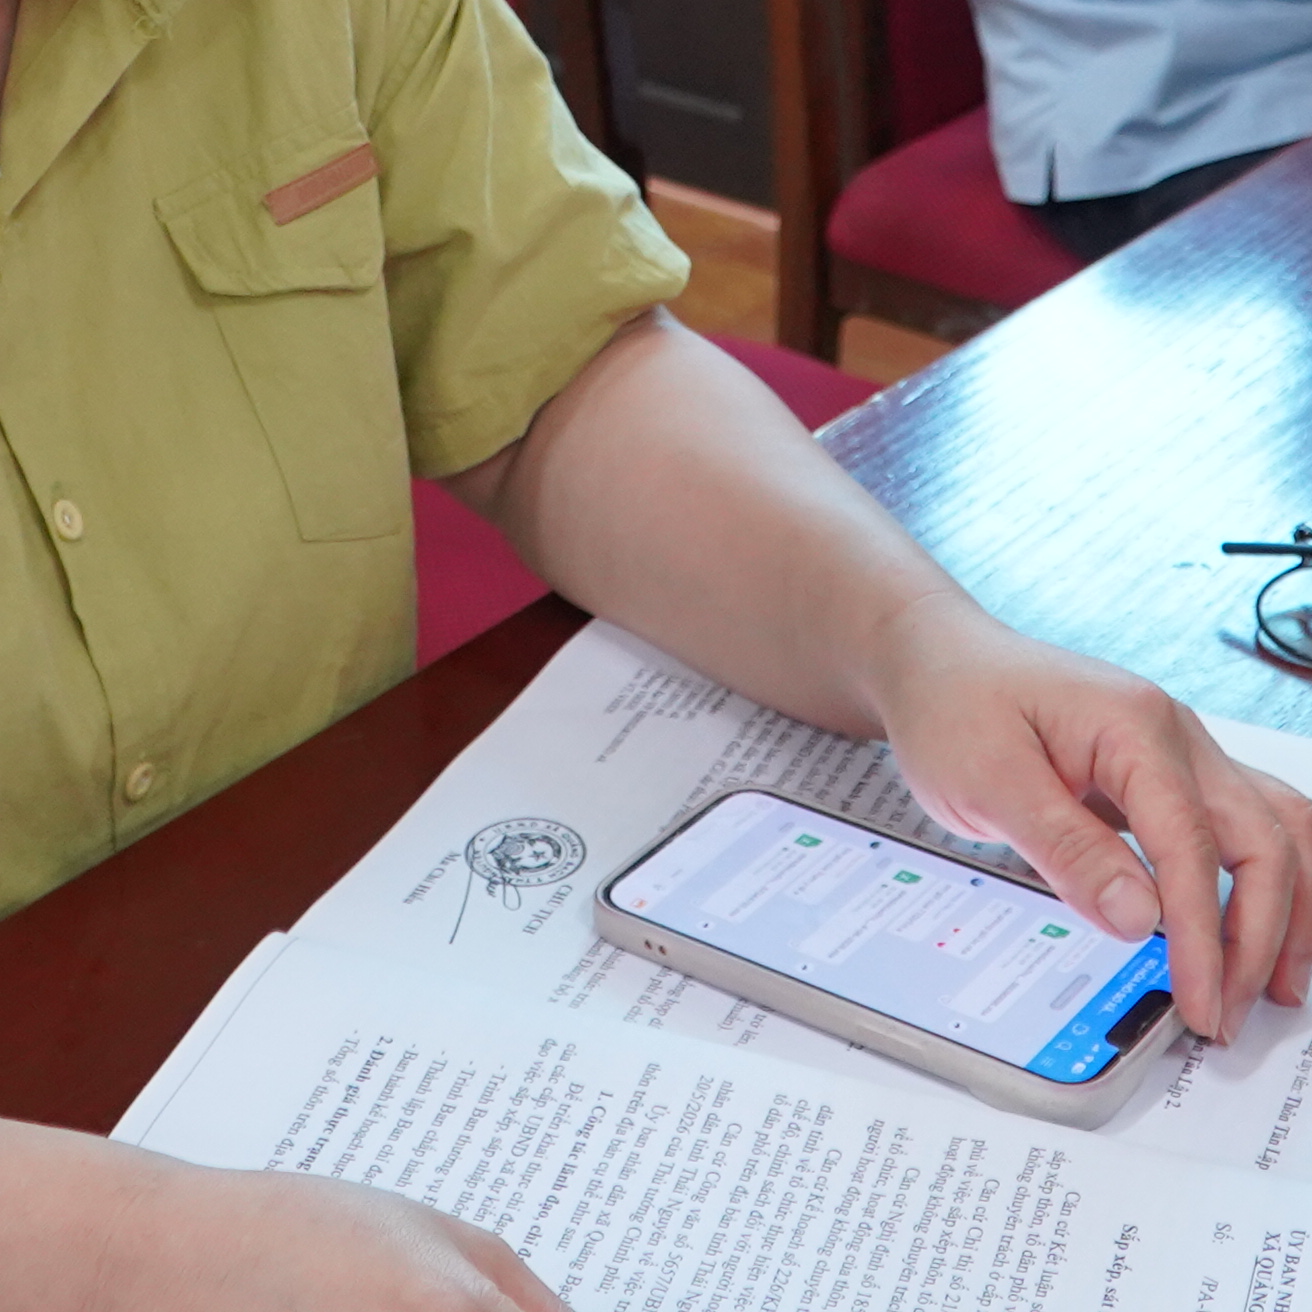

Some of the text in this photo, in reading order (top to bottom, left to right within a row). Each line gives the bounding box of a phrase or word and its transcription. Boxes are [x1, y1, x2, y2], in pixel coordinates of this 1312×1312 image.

[439, 852, 462, 866] Ma
[521, 883, 574, 935] CHỦ TỊCH
[272, 1037, 361, 1157] Tổng số thôn trên địa
[295, 1034, 394, 1172] 2. Đánh giá thực trạng
[1162, 1054, 1204, 1110] Tân Lập 2.
[1277, 1095, 1303, 1123] Thôn
[394, 1069, 477, 1188] Trình Ban chấp hành
[424, 1073, 508, 1194] Trình Ban thường vụ
[632, 1125, 658, 1149] ban
[1267, 1124, 1291, 1146] Tân
[522, 1089, 615, 1247] 1. Công tác lãnh đạo, chỉ
[593, 1074, 715, 1295] 20/5/2026 của Thủ tướng Chính phủ;
[616, 1150, 642, 1181] nhân
[897, 1166, 921, 1191] Căn
[1254, 1146, 1281, 1171] Lập
[603, 1183, 627, 1207] dân
[672, 1121, 743, 1251] Căn cứ Công văn số
[715, 1098, 812, 1293] chế độ, chính sách đối với người
[779, 1147, 843, 1268] Căn cứ Kế hoạch số
[891, 1192, 908, 1210] cứ
[594, 1209, 612, 1228] xã
[820, 1126, 914, 1311] về tổ chức, hoạt động của thôn,
[874, 1209, 905, 1243] Nghị
[916, 1137, 989, 1306] phủ về việc sắp xếp thôn, tổ
[948, 1177, 1001, 1292] Căn cứ Chỉ thị số
[975, 1146, 1047, 1308] không chuyên trách ở cấp
[1006, 1149, 1067, 1303] sắp xếp thôn, tổ dân phố
[1033, 1190, 1082, 1299] Căn cứ Kết luận
[1261, 1230, 1282, 1253] XÃ
[1286, 1229, 1310, 1252] ỦY
[567, 1229, 605, 1271] Quảng
[866, 1243, 891, 1272] định
[1100, 1223, 1141, 1309] Sắp xếp, sát
[1193, 1221, 1235, 1312] Số: /PA-
[1280, 1253, 1301, 1288] BAN
[859, 1272, 882, 1290] số
